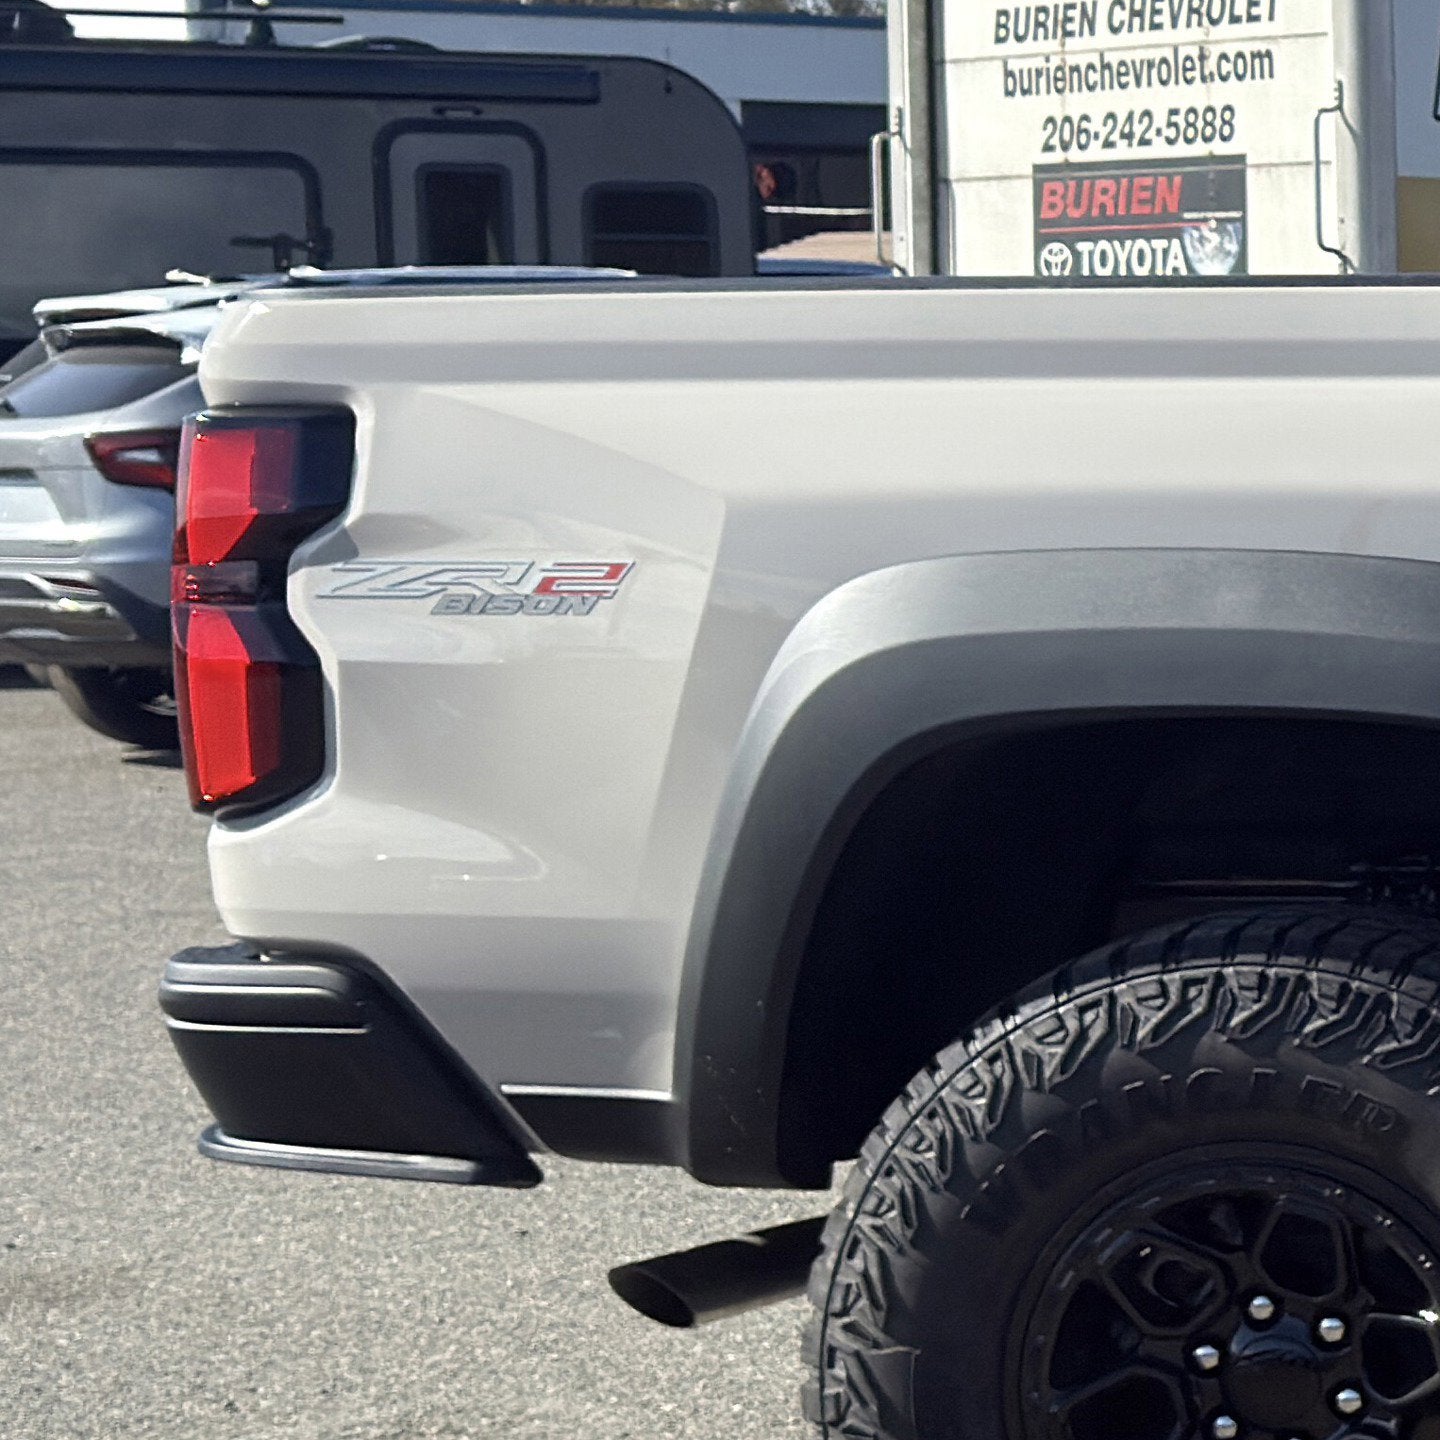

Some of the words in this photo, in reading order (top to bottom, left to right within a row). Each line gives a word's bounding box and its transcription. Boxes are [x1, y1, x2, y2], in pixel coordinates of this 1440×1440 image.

[994, 0, 1098, 44] BURIEN
[1003, 45, 1275, 97] burienchevrolet.com
[1039, 175, 1183, 220] BURIEN
[1075, 238, 1188, 277] TOYOTA
[315, 560, 636, 600] ZR2
[431, 594, 601, 616] BISON
